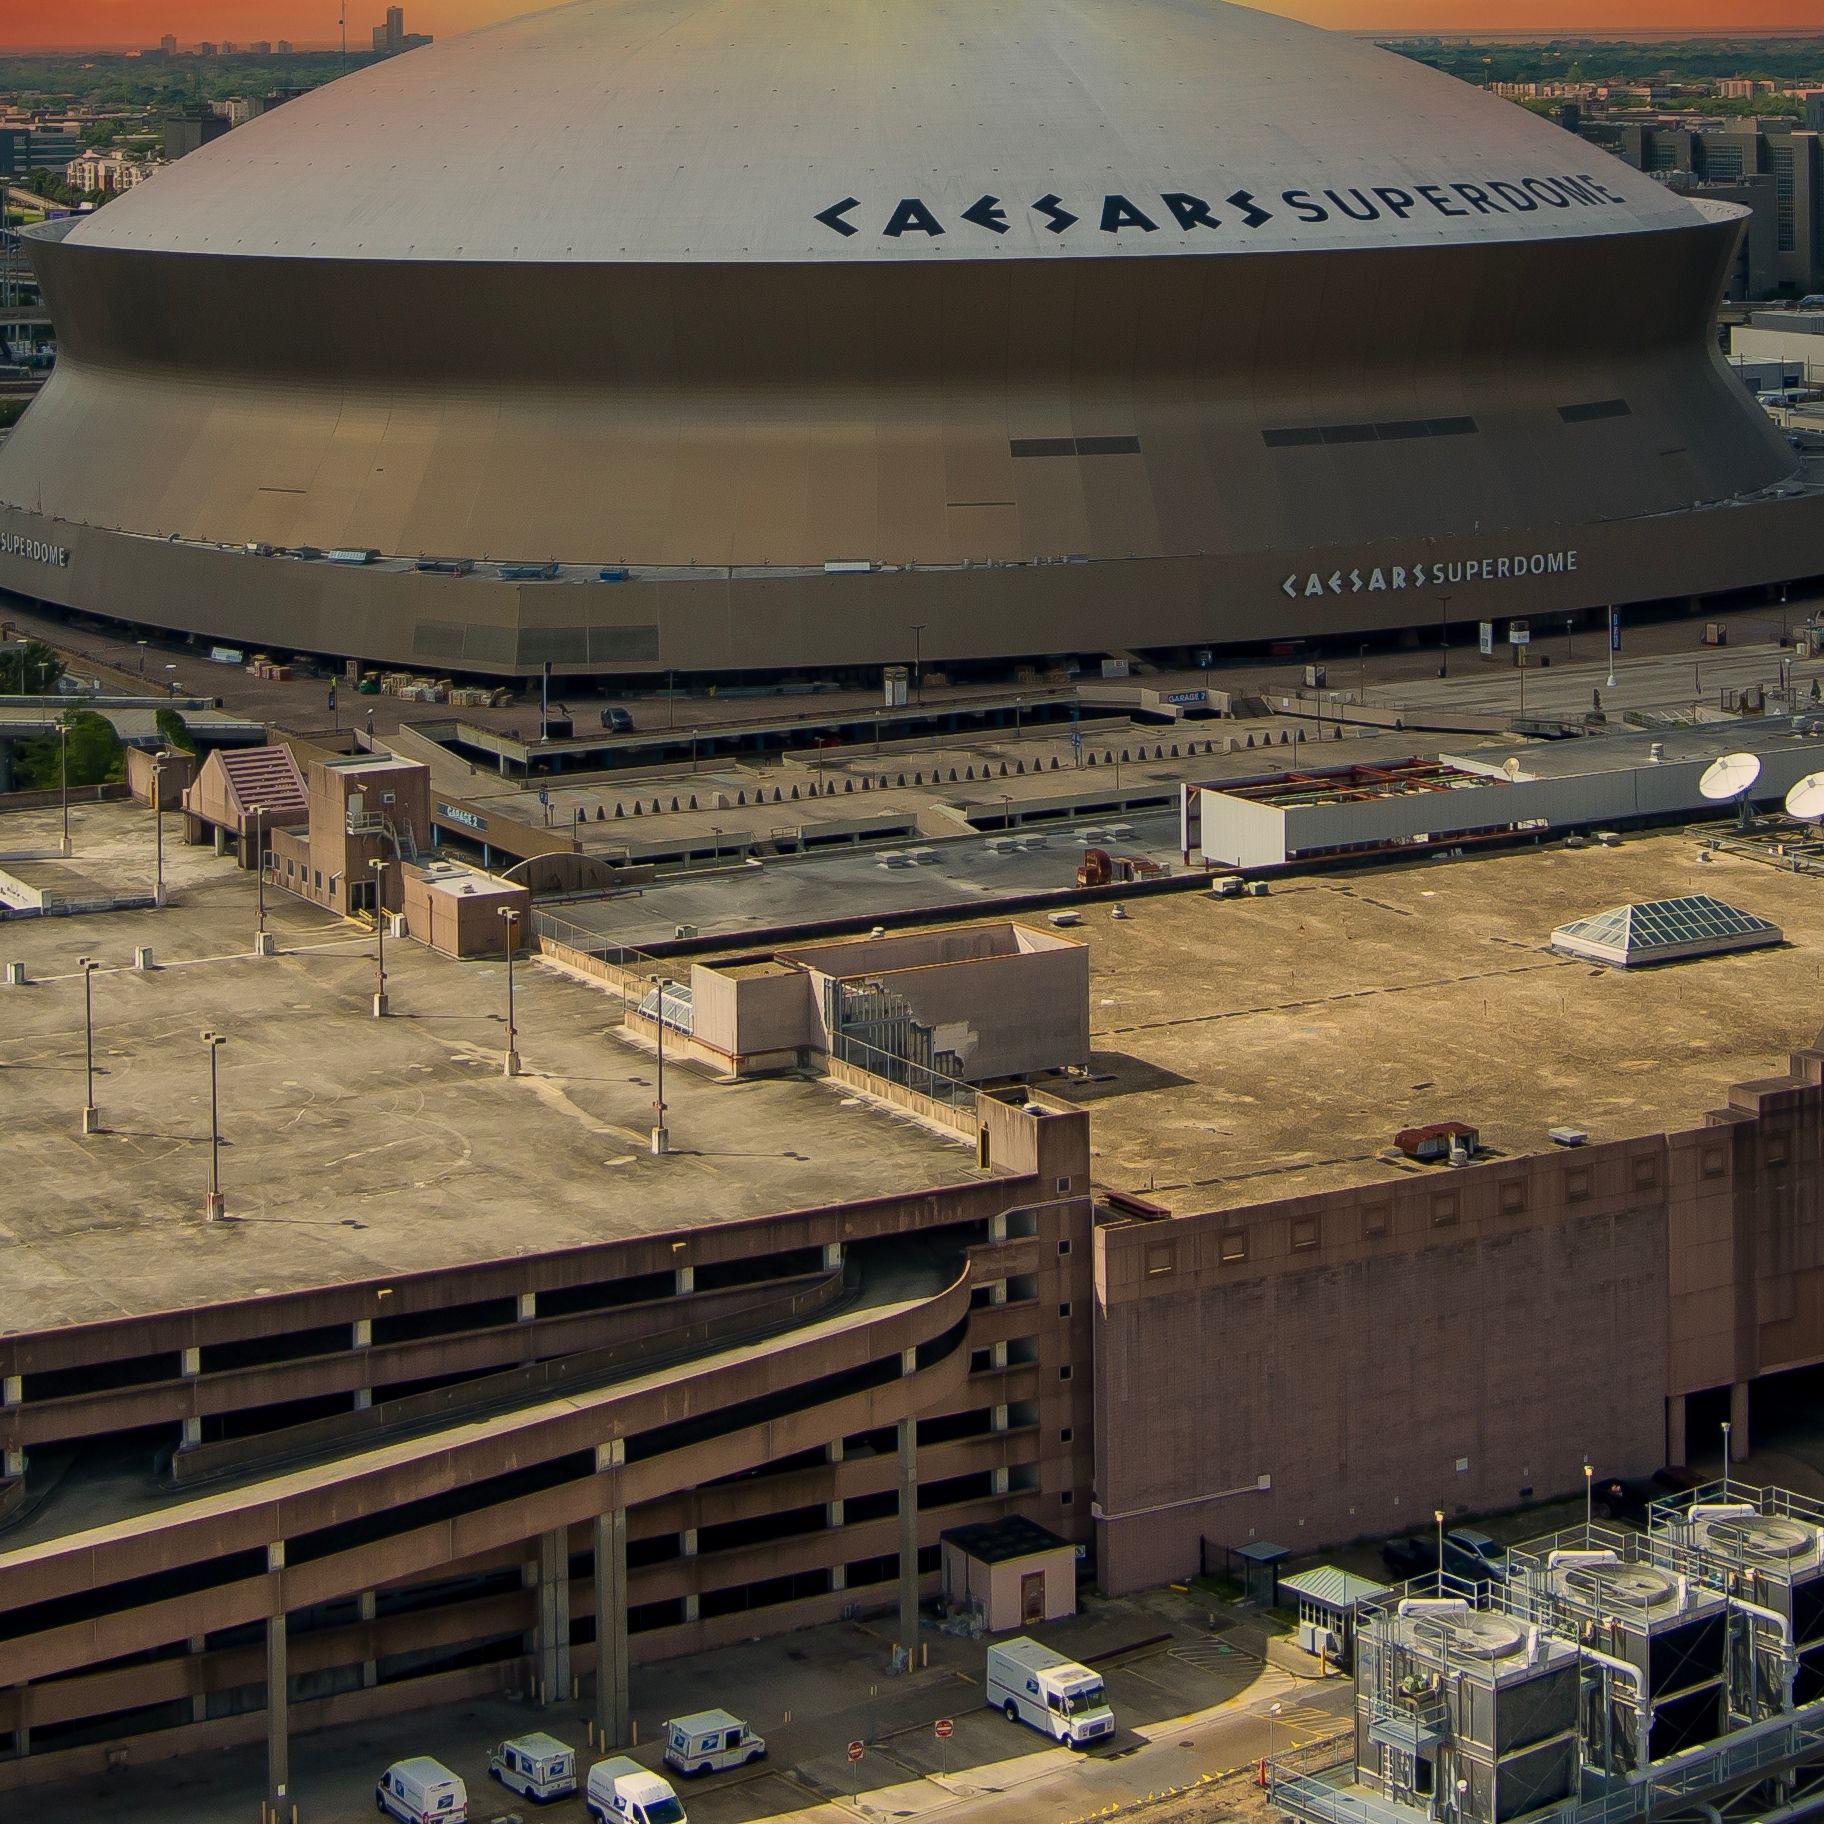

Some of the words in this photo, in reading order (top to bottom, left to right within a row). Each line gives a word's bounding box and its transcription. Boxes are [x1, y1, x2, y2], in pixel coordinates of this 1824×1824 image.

[812, 189, 1275, 238] CAESARS
[1279, 174, 1630, 223] SUPERDOME
[1, 532, 66, 568] SUPERDOME
[1282, 563, 1426, 598] CAESARS
[1432, 550, 1577, 585] SUPERDOME
